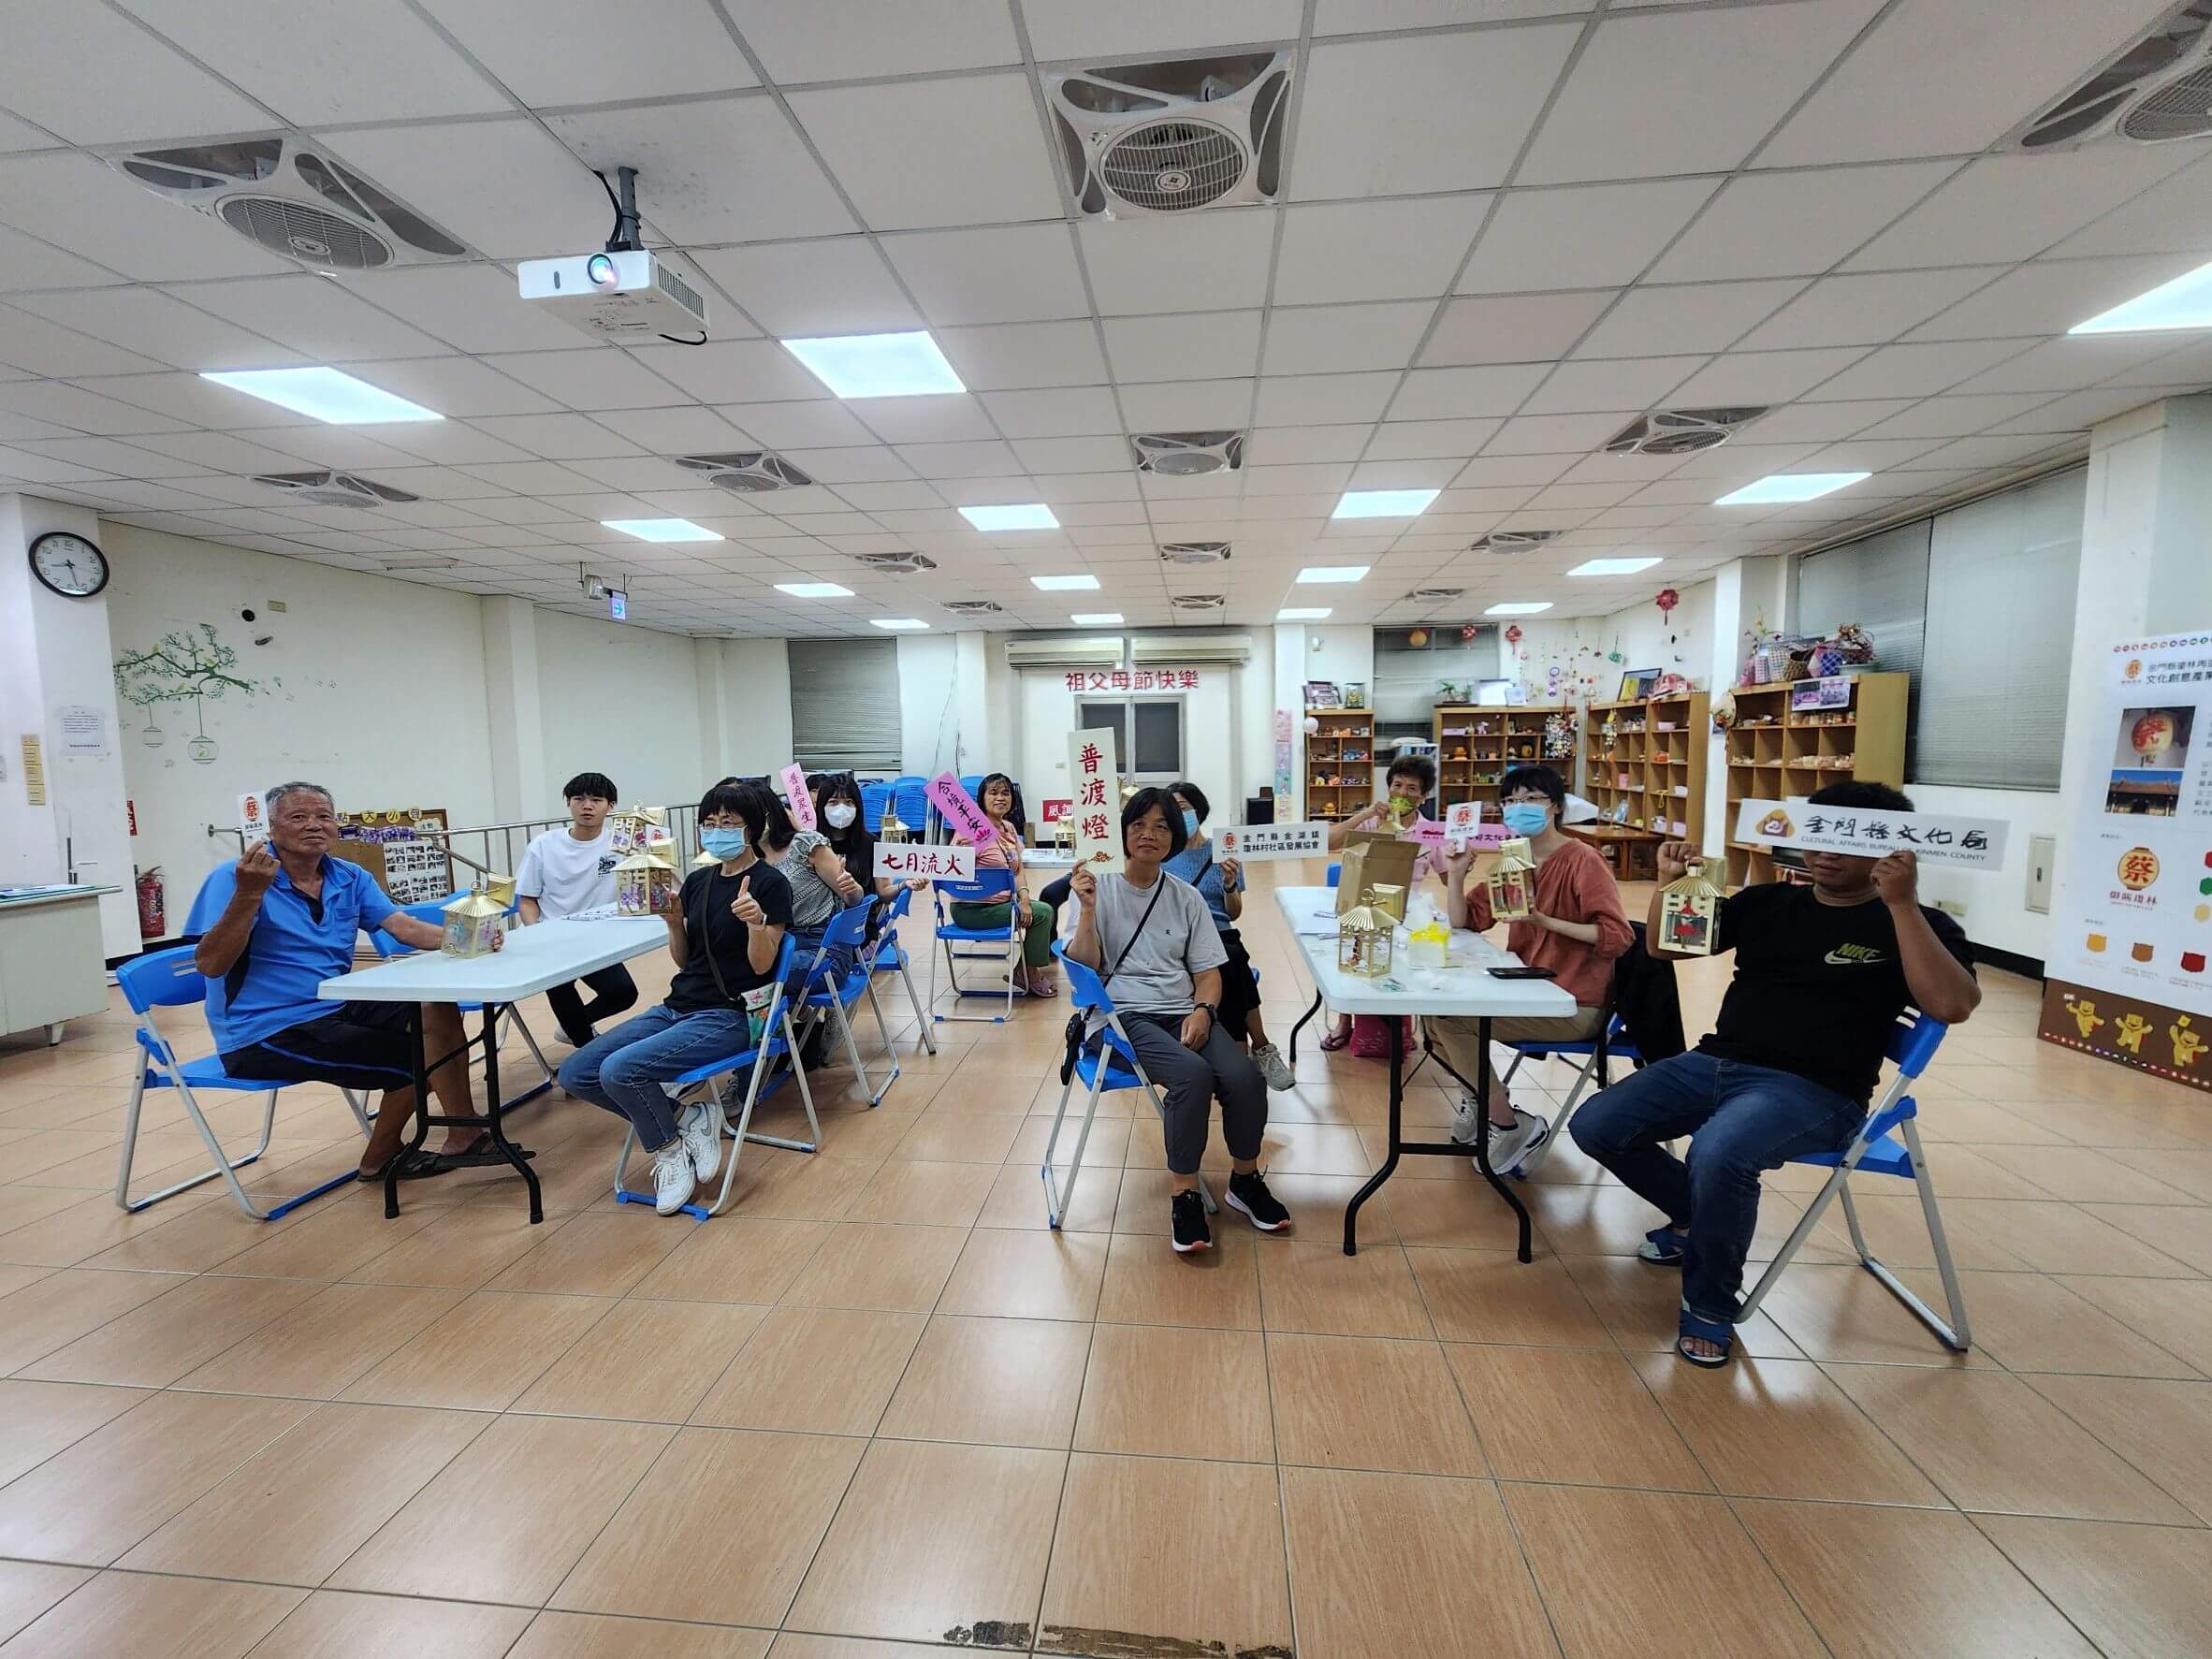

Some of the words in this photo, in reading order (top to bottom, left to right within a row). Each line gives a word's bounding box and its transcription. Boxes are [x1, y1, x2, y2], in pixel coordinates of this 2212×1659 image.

[1065, 670, 1199, 692] 祖父母節快樂
[1078, 743, 1110, 840] 普渡燈
[1801, 836, 1835, 846] CULTURAL
[1949, 851, 1986, 861] COUNTY
[882, 852, 964, 876] 七月流火
[2124, 855, 2154, 883] 蔡
[1836, 943, 1881, 960] NIKE
